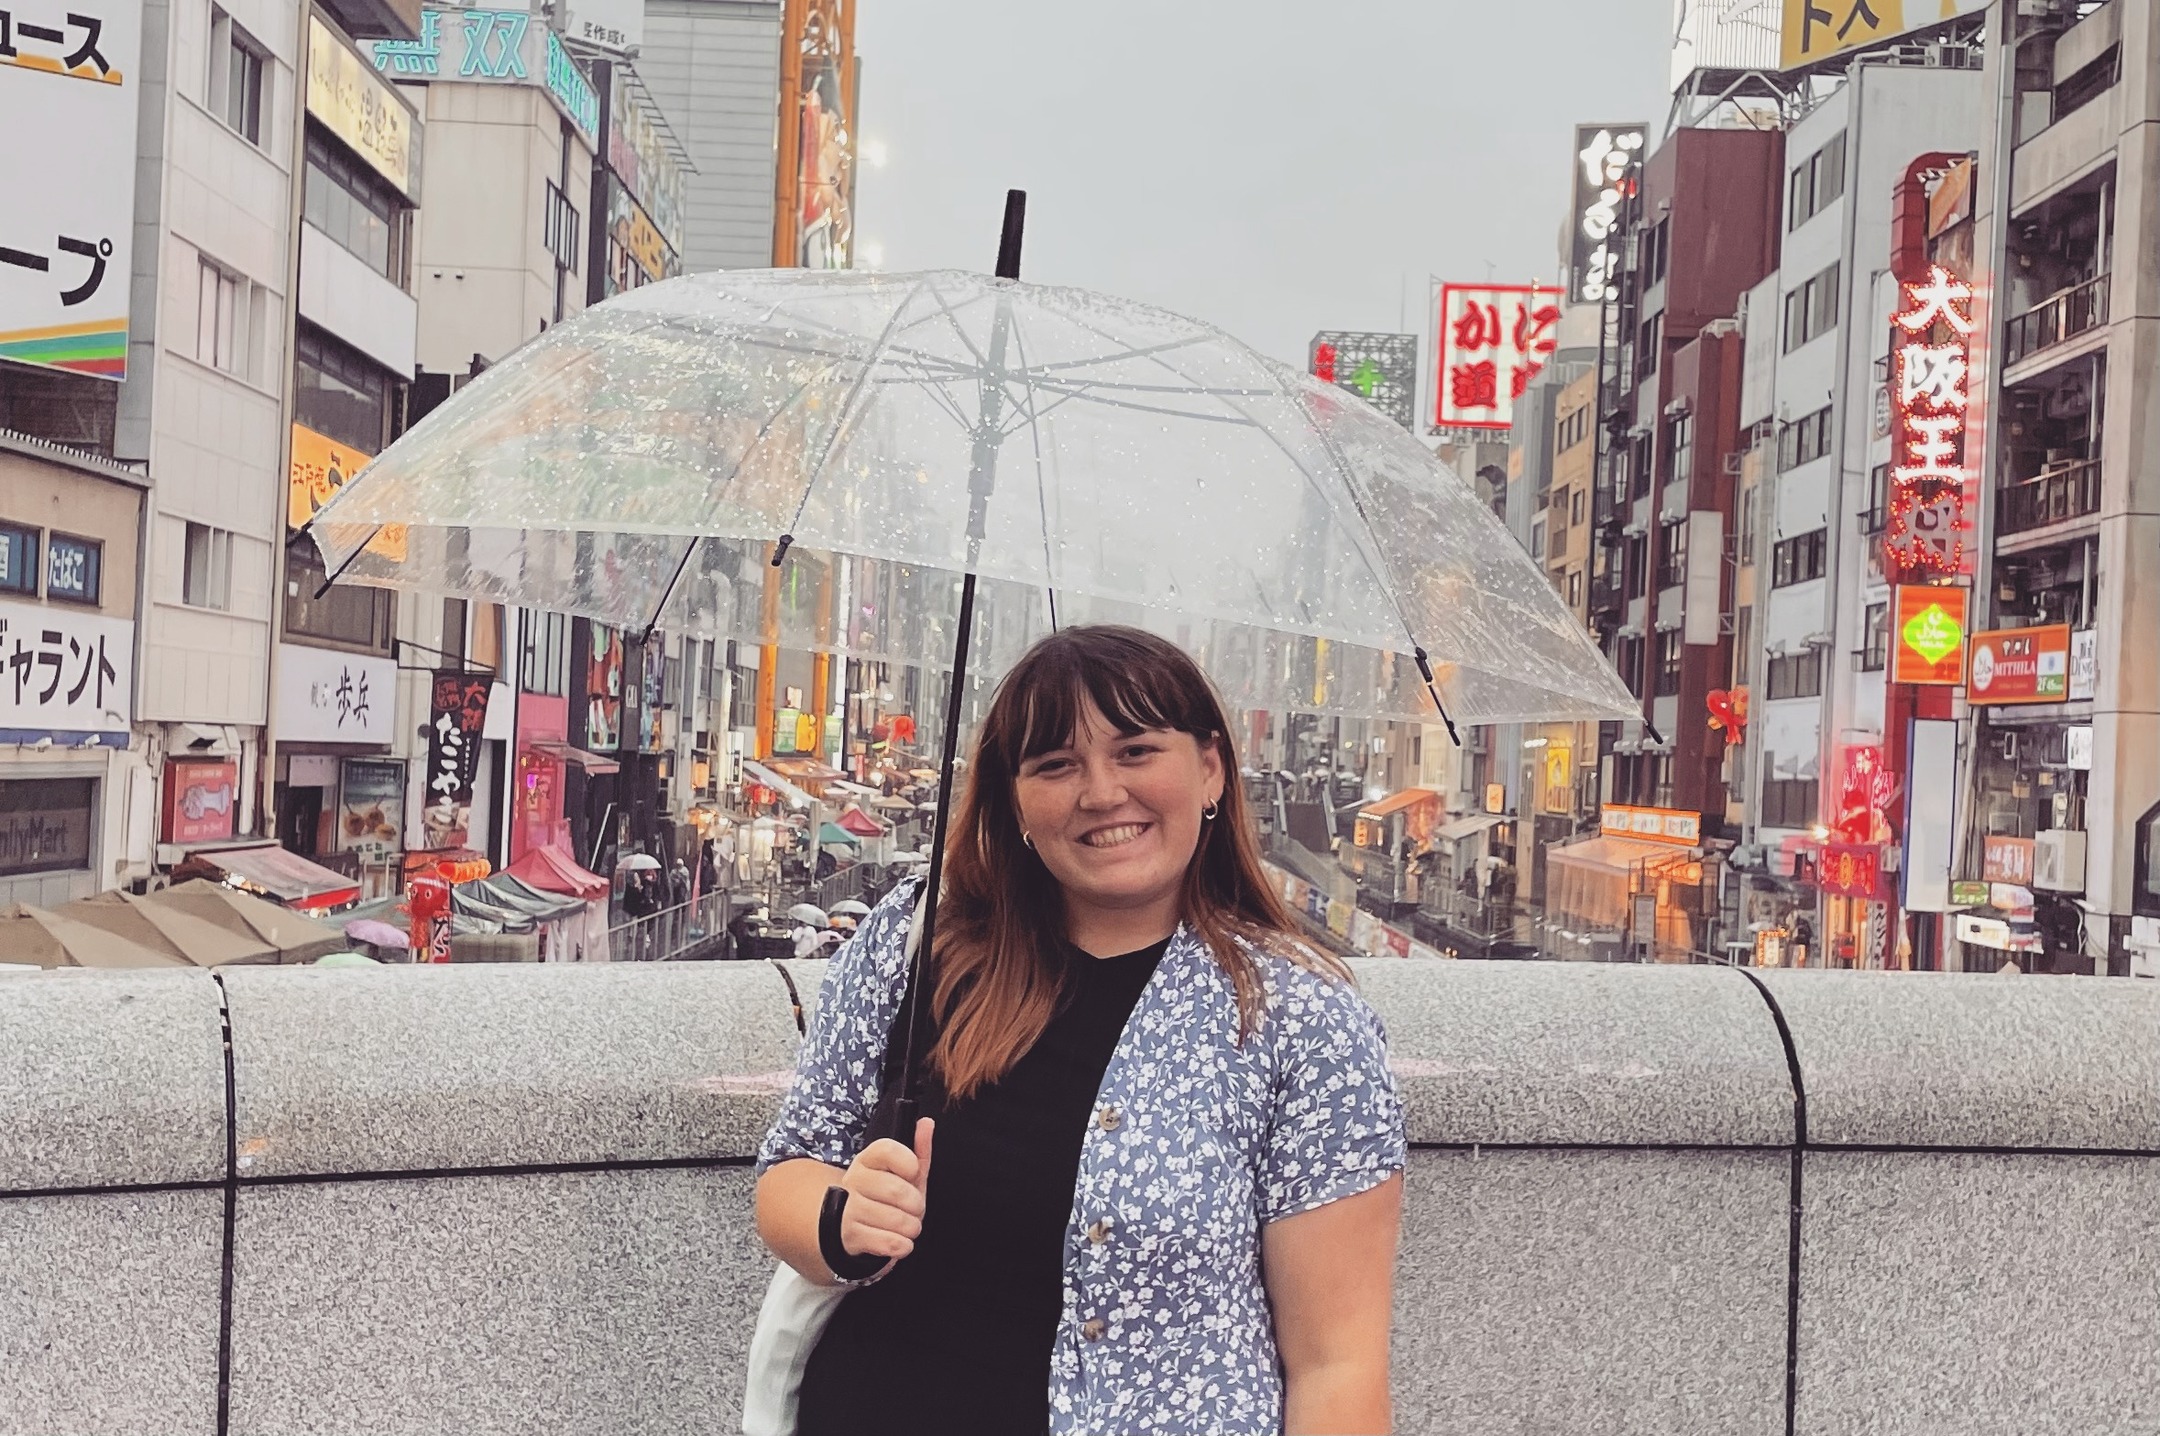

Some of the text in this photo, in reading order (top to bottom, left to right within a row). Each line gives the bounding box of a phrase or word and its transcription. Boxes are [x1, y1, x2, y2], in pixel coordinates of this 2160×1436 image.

[1453, 300, 1560, 353] かに
[48, 546, 84, 591] たばこ
[0, 619, 116, 709] ャラント
[1994, 659, 2036, 677] MITHILA
[336, 665, 369, 728] 歩兵
[431, 712, 463, 824] たこやき
